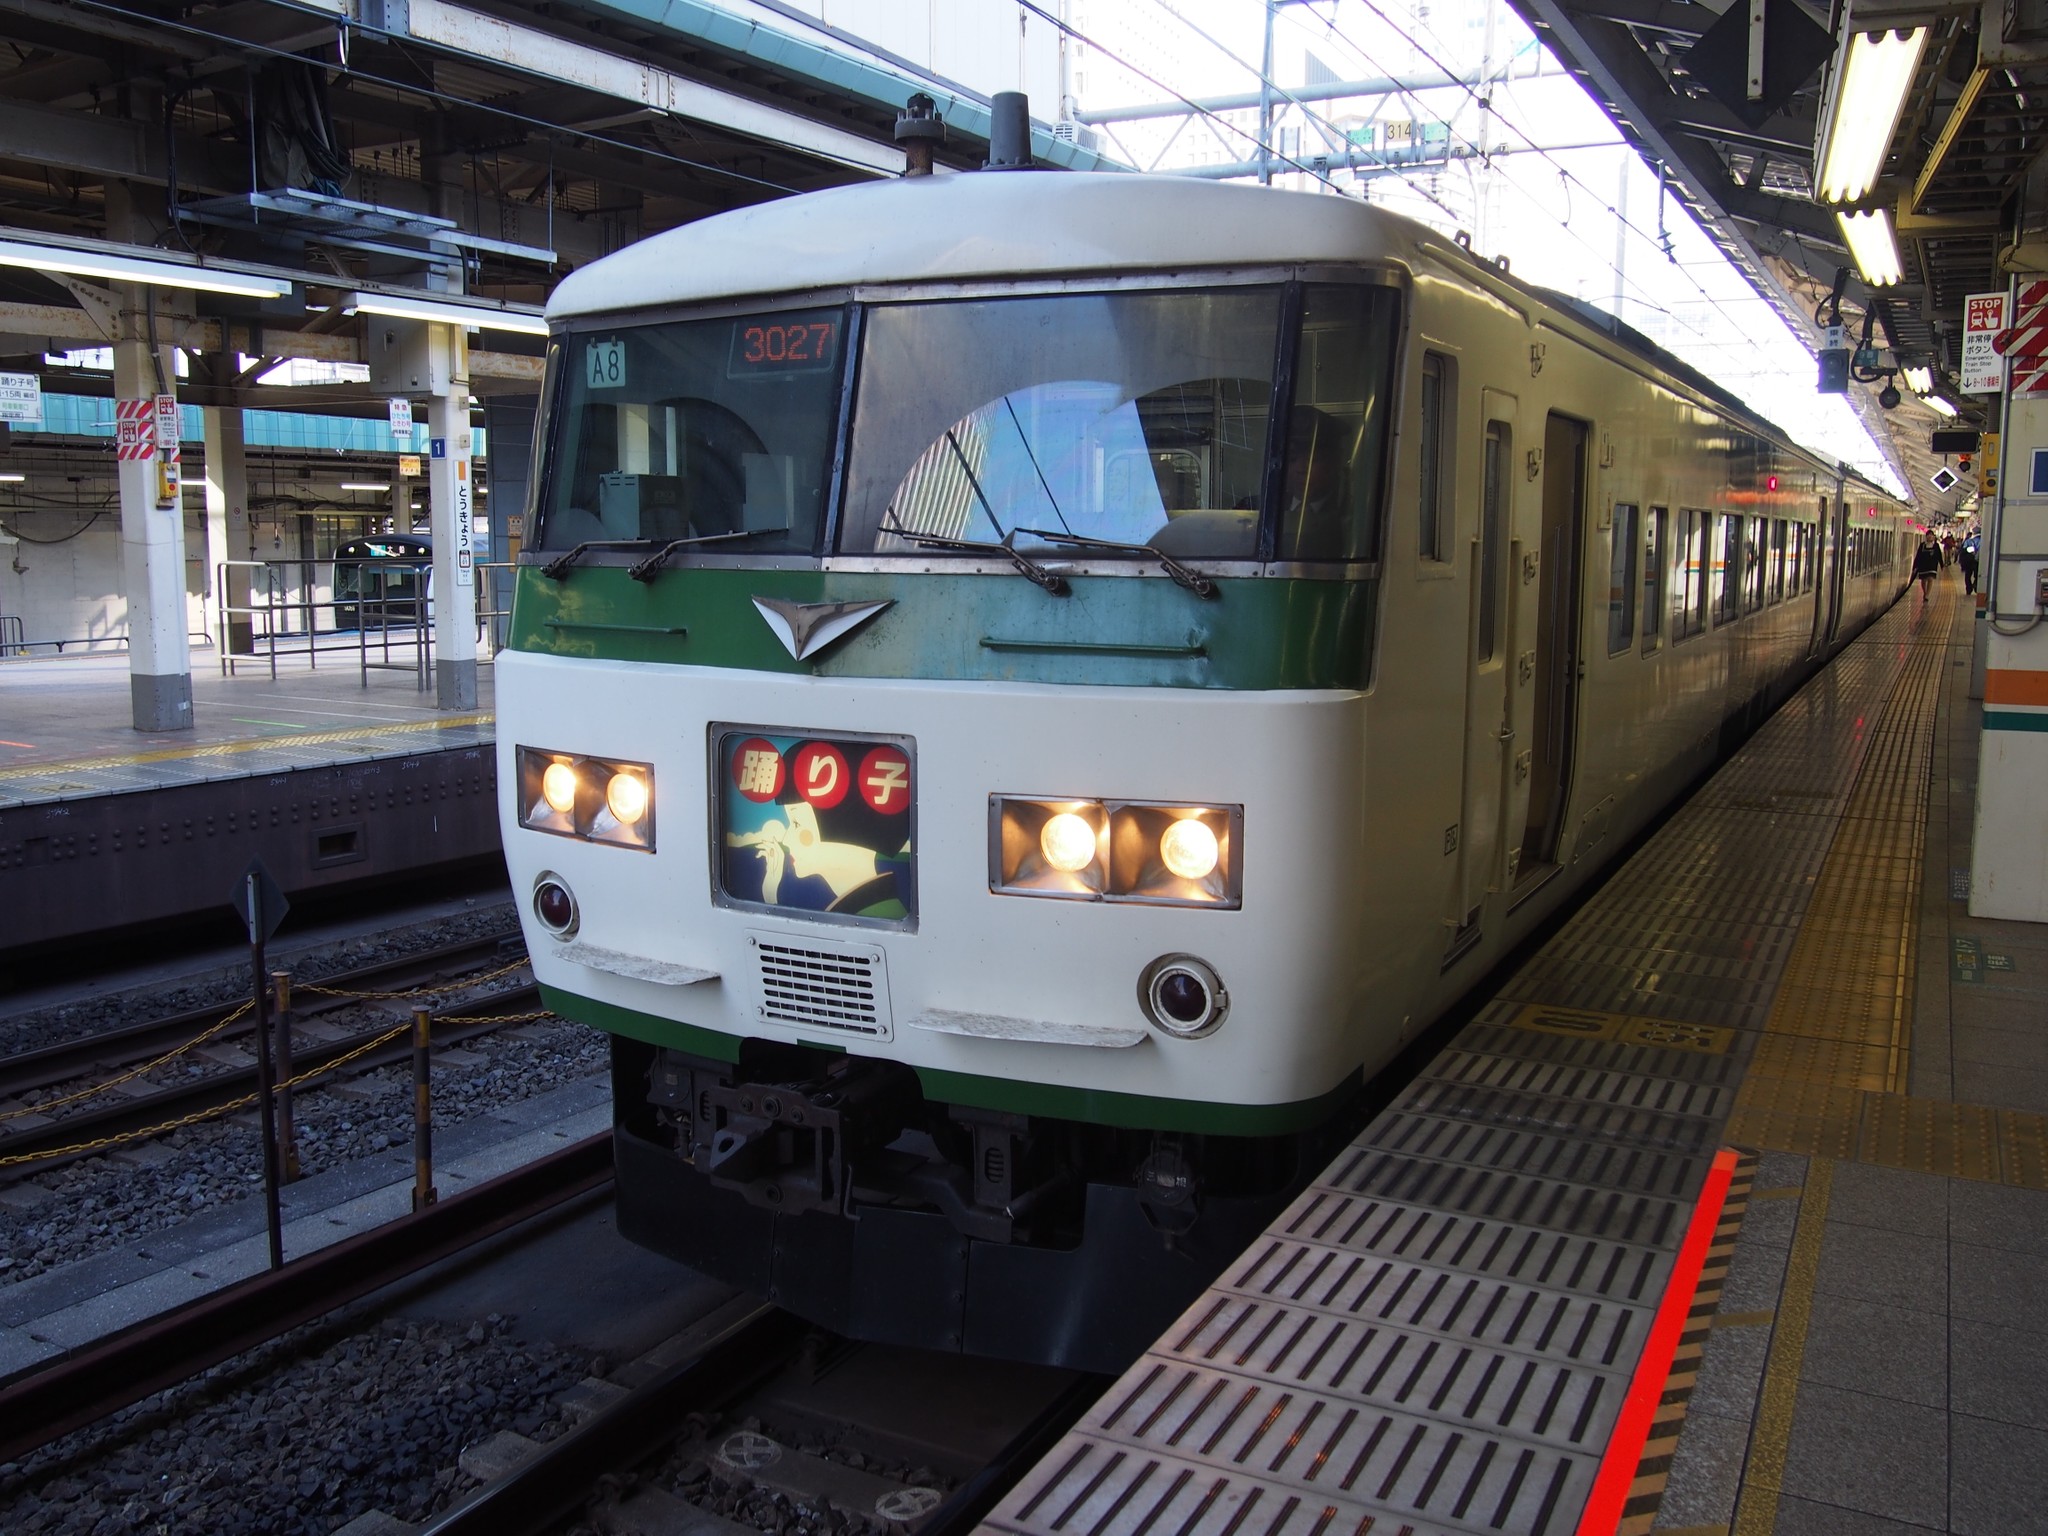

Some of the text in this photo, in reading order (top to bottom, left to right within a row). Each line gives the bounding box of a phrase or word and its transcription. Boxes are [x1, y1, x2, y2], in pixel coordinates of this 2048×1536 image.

[1387, 123, 1412, 140] 314
[1970, 299, 2001, 310] STOP
[744, 323, 836, 362] 3027
[1966, 334, 1995, 345] 非常停
[1966, 346, 1991, 355] ボタン
[592, 349, 620, 384] A8
[1, 377, 34, 388] 踊り子号
[435, 442, 441, 455] 1
[458, 485, 469, 547] とうきょう
[738, 749, 909, 806] 踊り子
